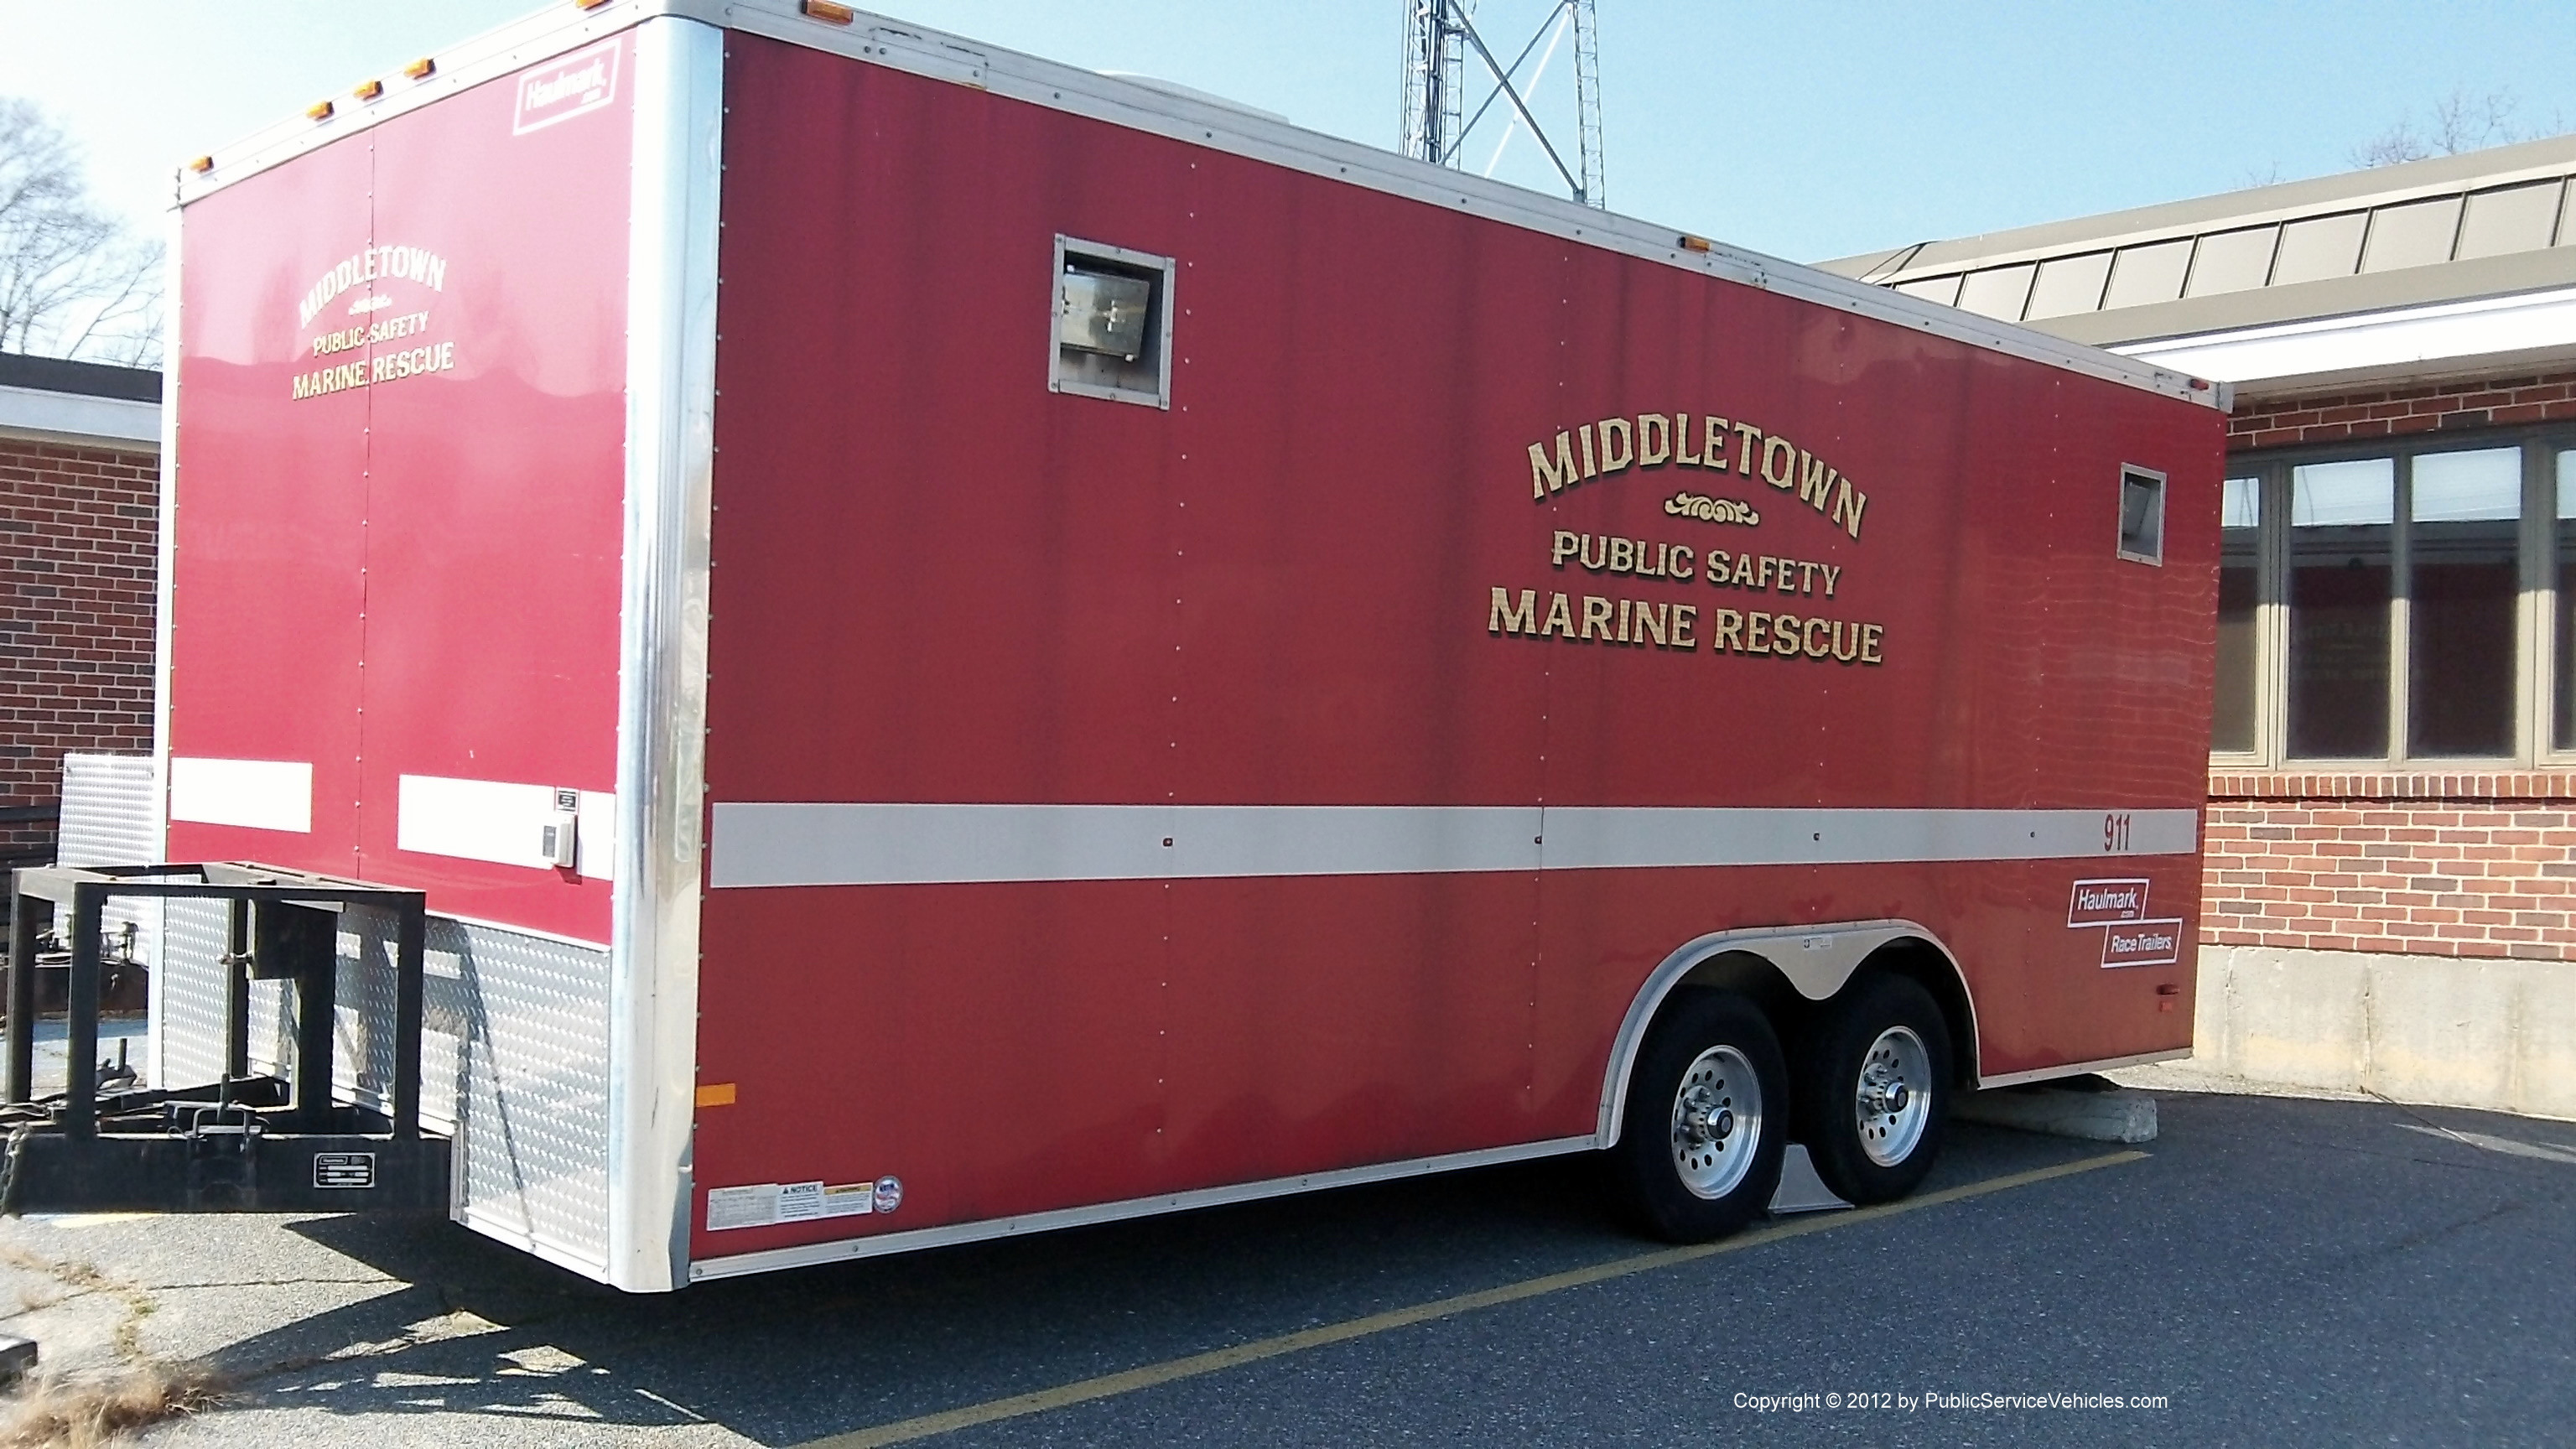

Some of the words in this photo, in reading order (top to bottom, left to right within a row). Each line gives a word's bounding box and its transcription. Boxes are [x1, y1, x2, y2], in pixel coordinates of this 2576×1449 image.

[299, 246, 447, 330] MIDDLETOWN
[313, 326, 365, 358] PUBLIC
[368, 310, 428, 344] SAFETY
[293, 361, 367, 401] MARINE
[371, 341, 454, 384] RESCUE
[1527, 413, 1867, 542] MIDDLETOWN
[1550, 529, 1695, 580] PUBLIC
[1706, 549, 1842, 595] SAFETY
[1488, 586, 1698, 648] MARINE
[1713, 608, 1884, 664] RESCUE
[2104, 813, 2131, 851] 911
[2077, 887, 2137, 911] Haulmark
[2111, 934, 2137, 953] Race
[2137, 932, 2172, 952] Trailers
